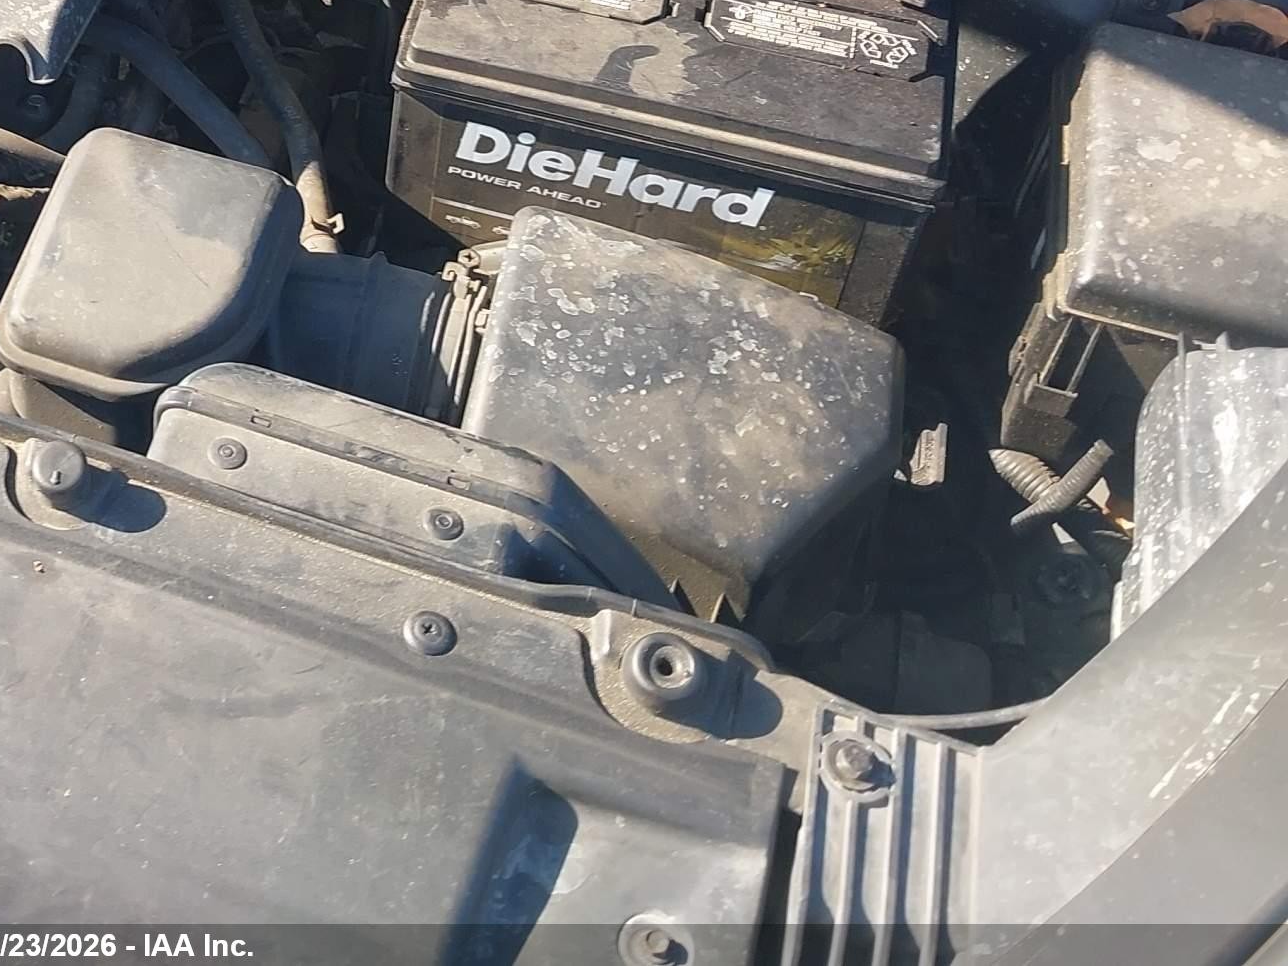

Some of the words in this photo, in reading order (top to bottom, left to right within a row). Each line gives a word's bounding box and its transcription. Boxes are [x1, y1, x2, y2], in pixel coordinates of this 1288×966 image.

[447, 165, 522, 191] POWER
[526, 185, 604, 209] AHEAD
[455, 121, 775, 227] DieHard
